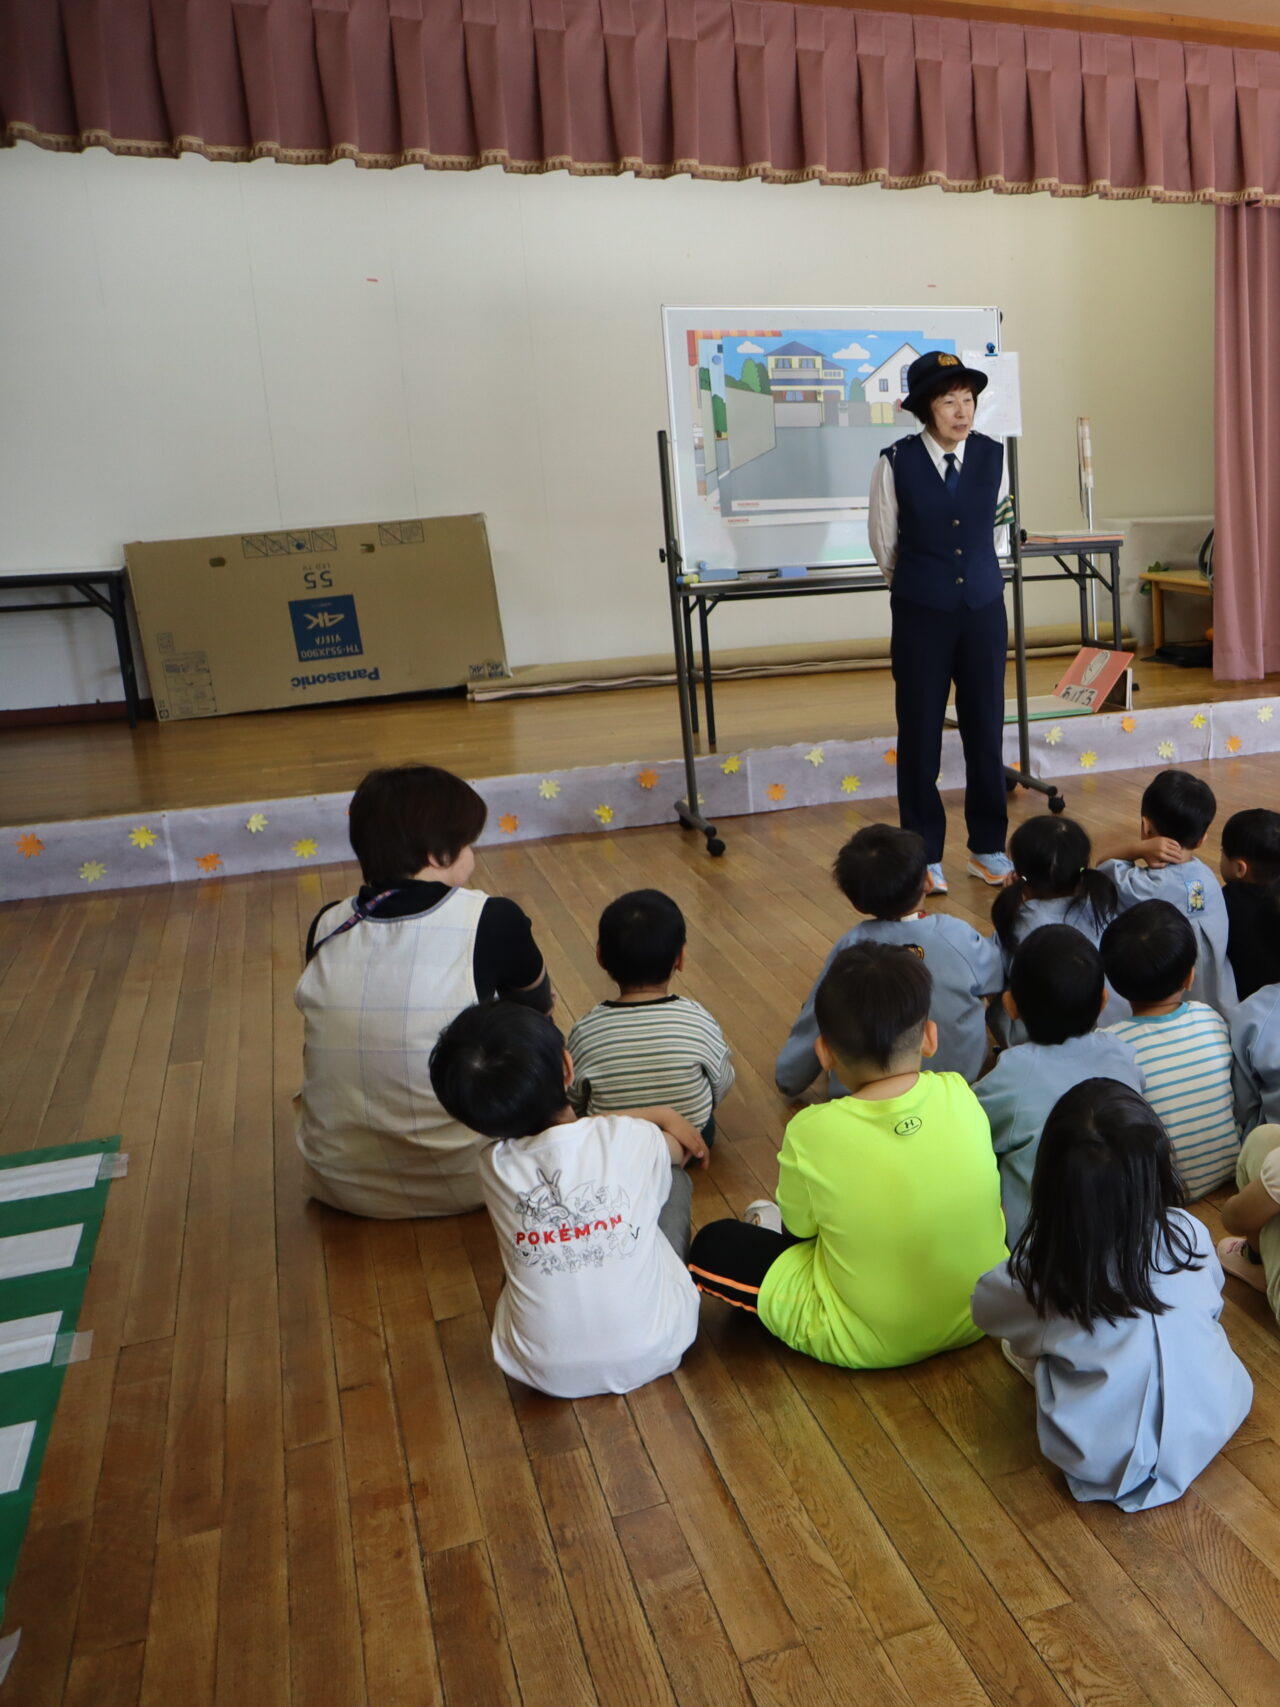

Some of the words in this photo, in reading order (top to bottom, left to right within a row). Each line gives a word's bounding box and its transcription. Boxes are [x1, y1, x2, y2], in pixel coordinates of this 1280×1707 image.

[303, 570, 333, 590] 55
[303, 611, 345, 630] 4K
[290, 666, 381, 690] Panasonic
